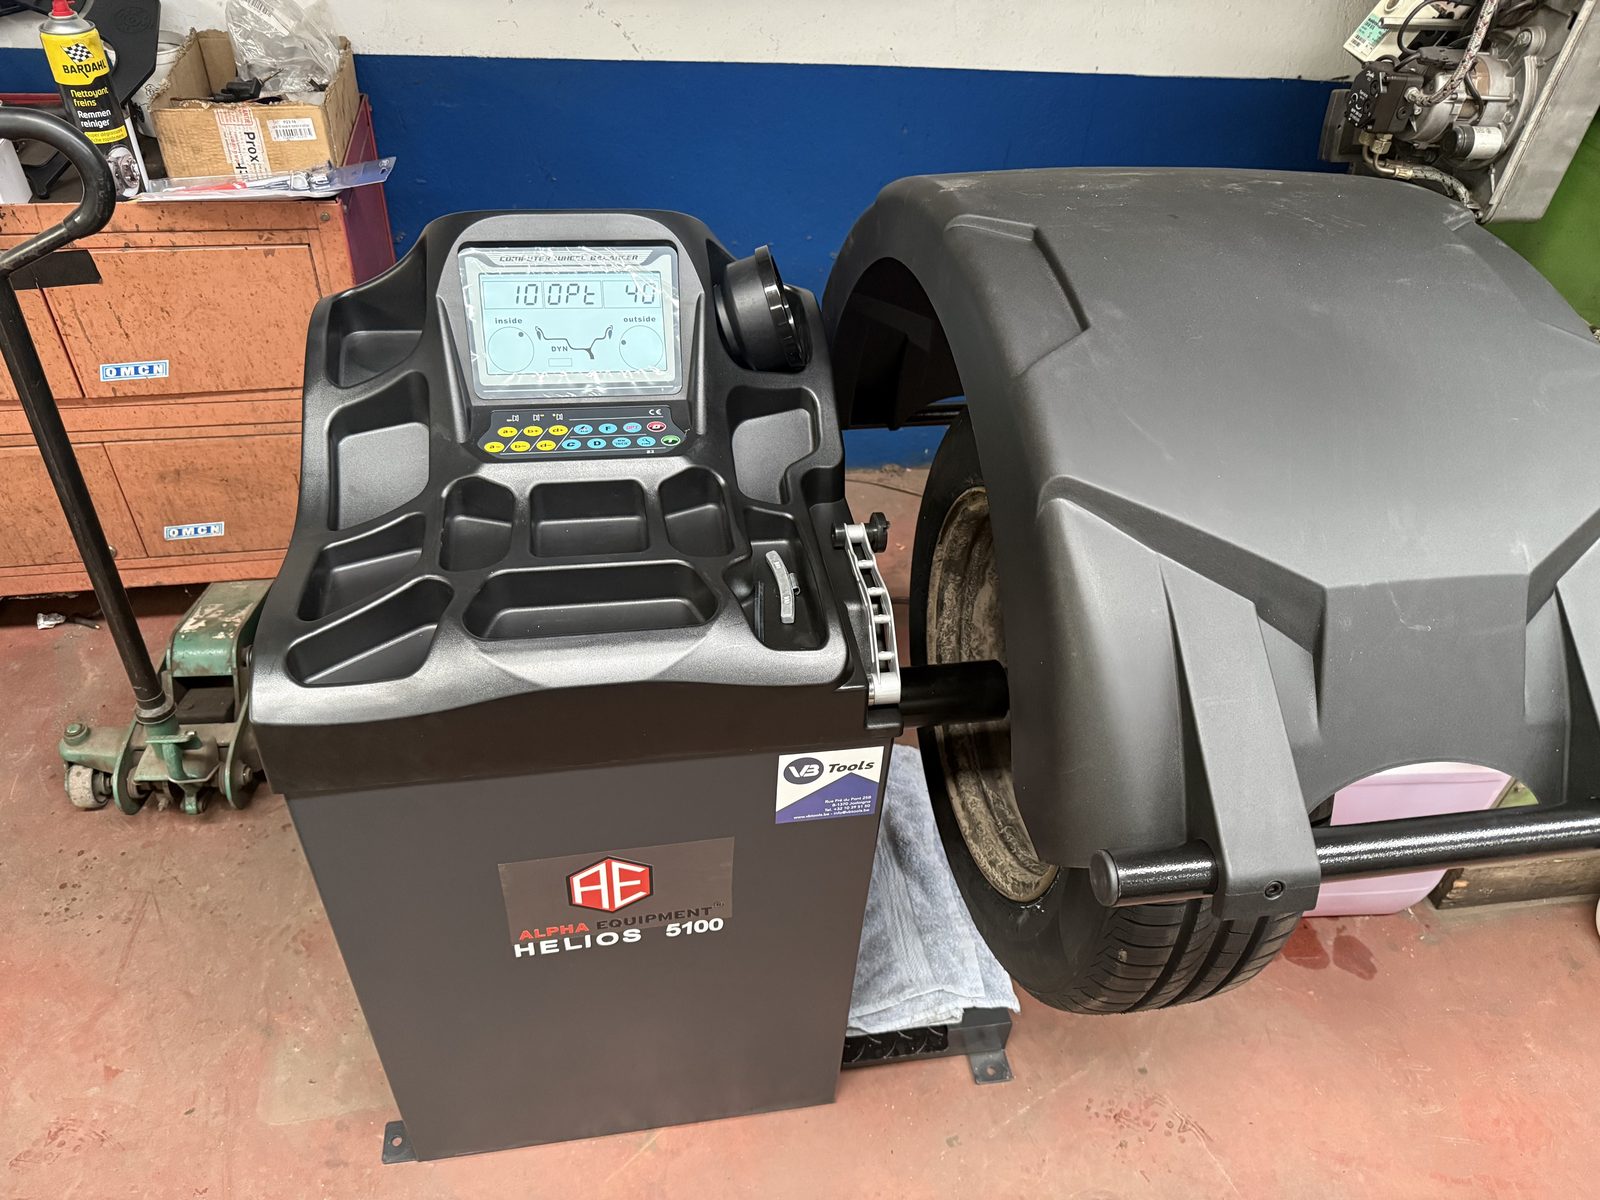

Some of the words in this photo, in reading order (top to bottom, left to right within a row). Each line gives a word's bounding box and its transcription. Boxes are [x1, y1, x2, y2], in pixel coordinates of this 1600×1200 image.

[63, 59, 107, 78] BARDAHL
[70, 86, 109, 98] Nettoyant
[73, 99, 97, 107] freins
[77, 109, 111, 119] Remmen
[80, 119, 110, 129] reiniger
[244, 131, 259, 163] Prox
[515, 284, 539, 306] 10
[625, 283, 656, 305] 40
[494, 317, 523, 325] inside
[105, 364, 164, 377] OMCN
[169, 524, 220, 537] OMCN
[789, 764, 819, 778] VB
[829, 761, 875, 773] Tools
[519, 922, 589, 941] ALPHA
[596, 906, 713, 930] EQUIPMENT
[513, 929, 642, 958] HELIOS
[665, 917, 724, 937] 5100
